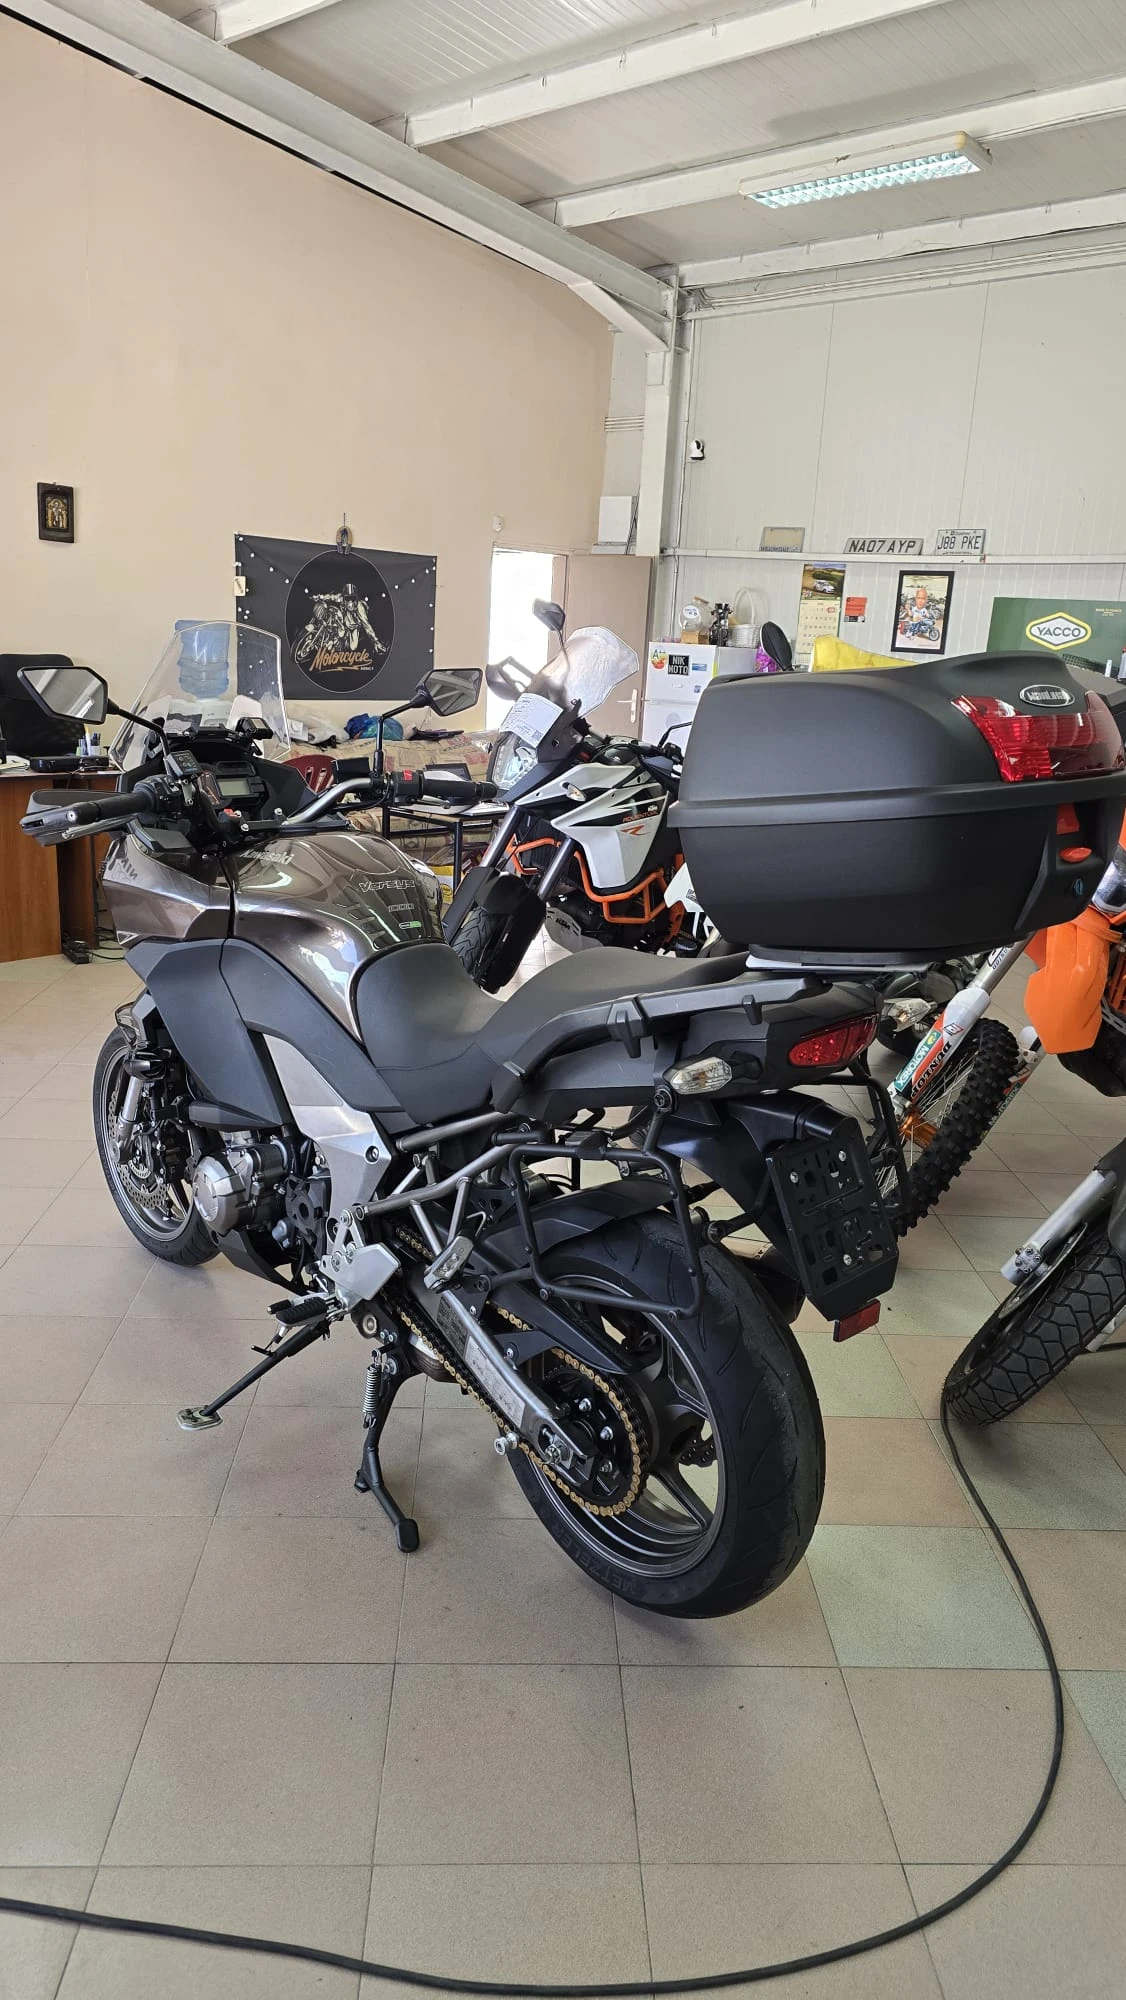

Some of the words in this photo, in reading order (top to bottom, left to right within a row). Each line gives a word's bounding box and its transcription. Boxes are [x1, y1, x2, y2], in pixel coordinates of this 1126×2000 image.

[848, 539, 887, 553] NA07
[886, 540, 917, 554] AYP
[937, 535, 956, 550] J88
[961, 535, 982, 550] PKE
[1036, 626, 1082, 638] YACCO
[309, 647, 371, 672] Motorcycle
[672, 655, 686, 666] NIK
[668, 665, 689, 675] MOTO
[240, 849, 294, 865] Kawasaki
[359, 879, 416, 893] Versys
[899, 1045, 931, 1088] MOTOREX
[910, 1041, 952, 1099] DUNLOP
